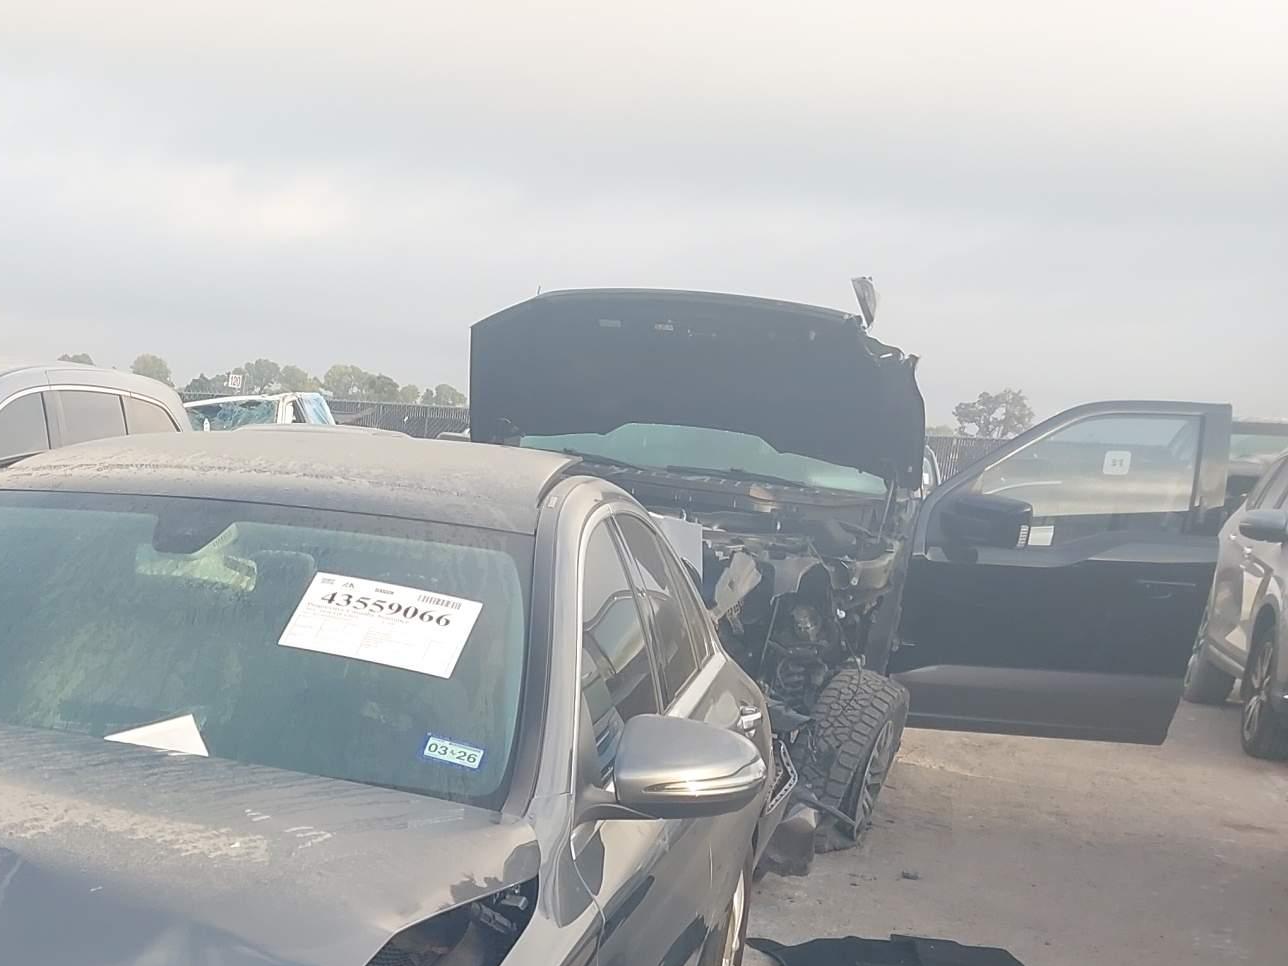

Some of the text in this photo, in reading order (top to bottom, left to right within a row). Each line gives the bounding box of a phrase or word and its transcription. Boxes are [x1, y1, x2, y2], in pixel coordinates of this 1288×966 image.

[321, 591, 451, 627] 43559066
[428, 742, 478, 763] 03 26
